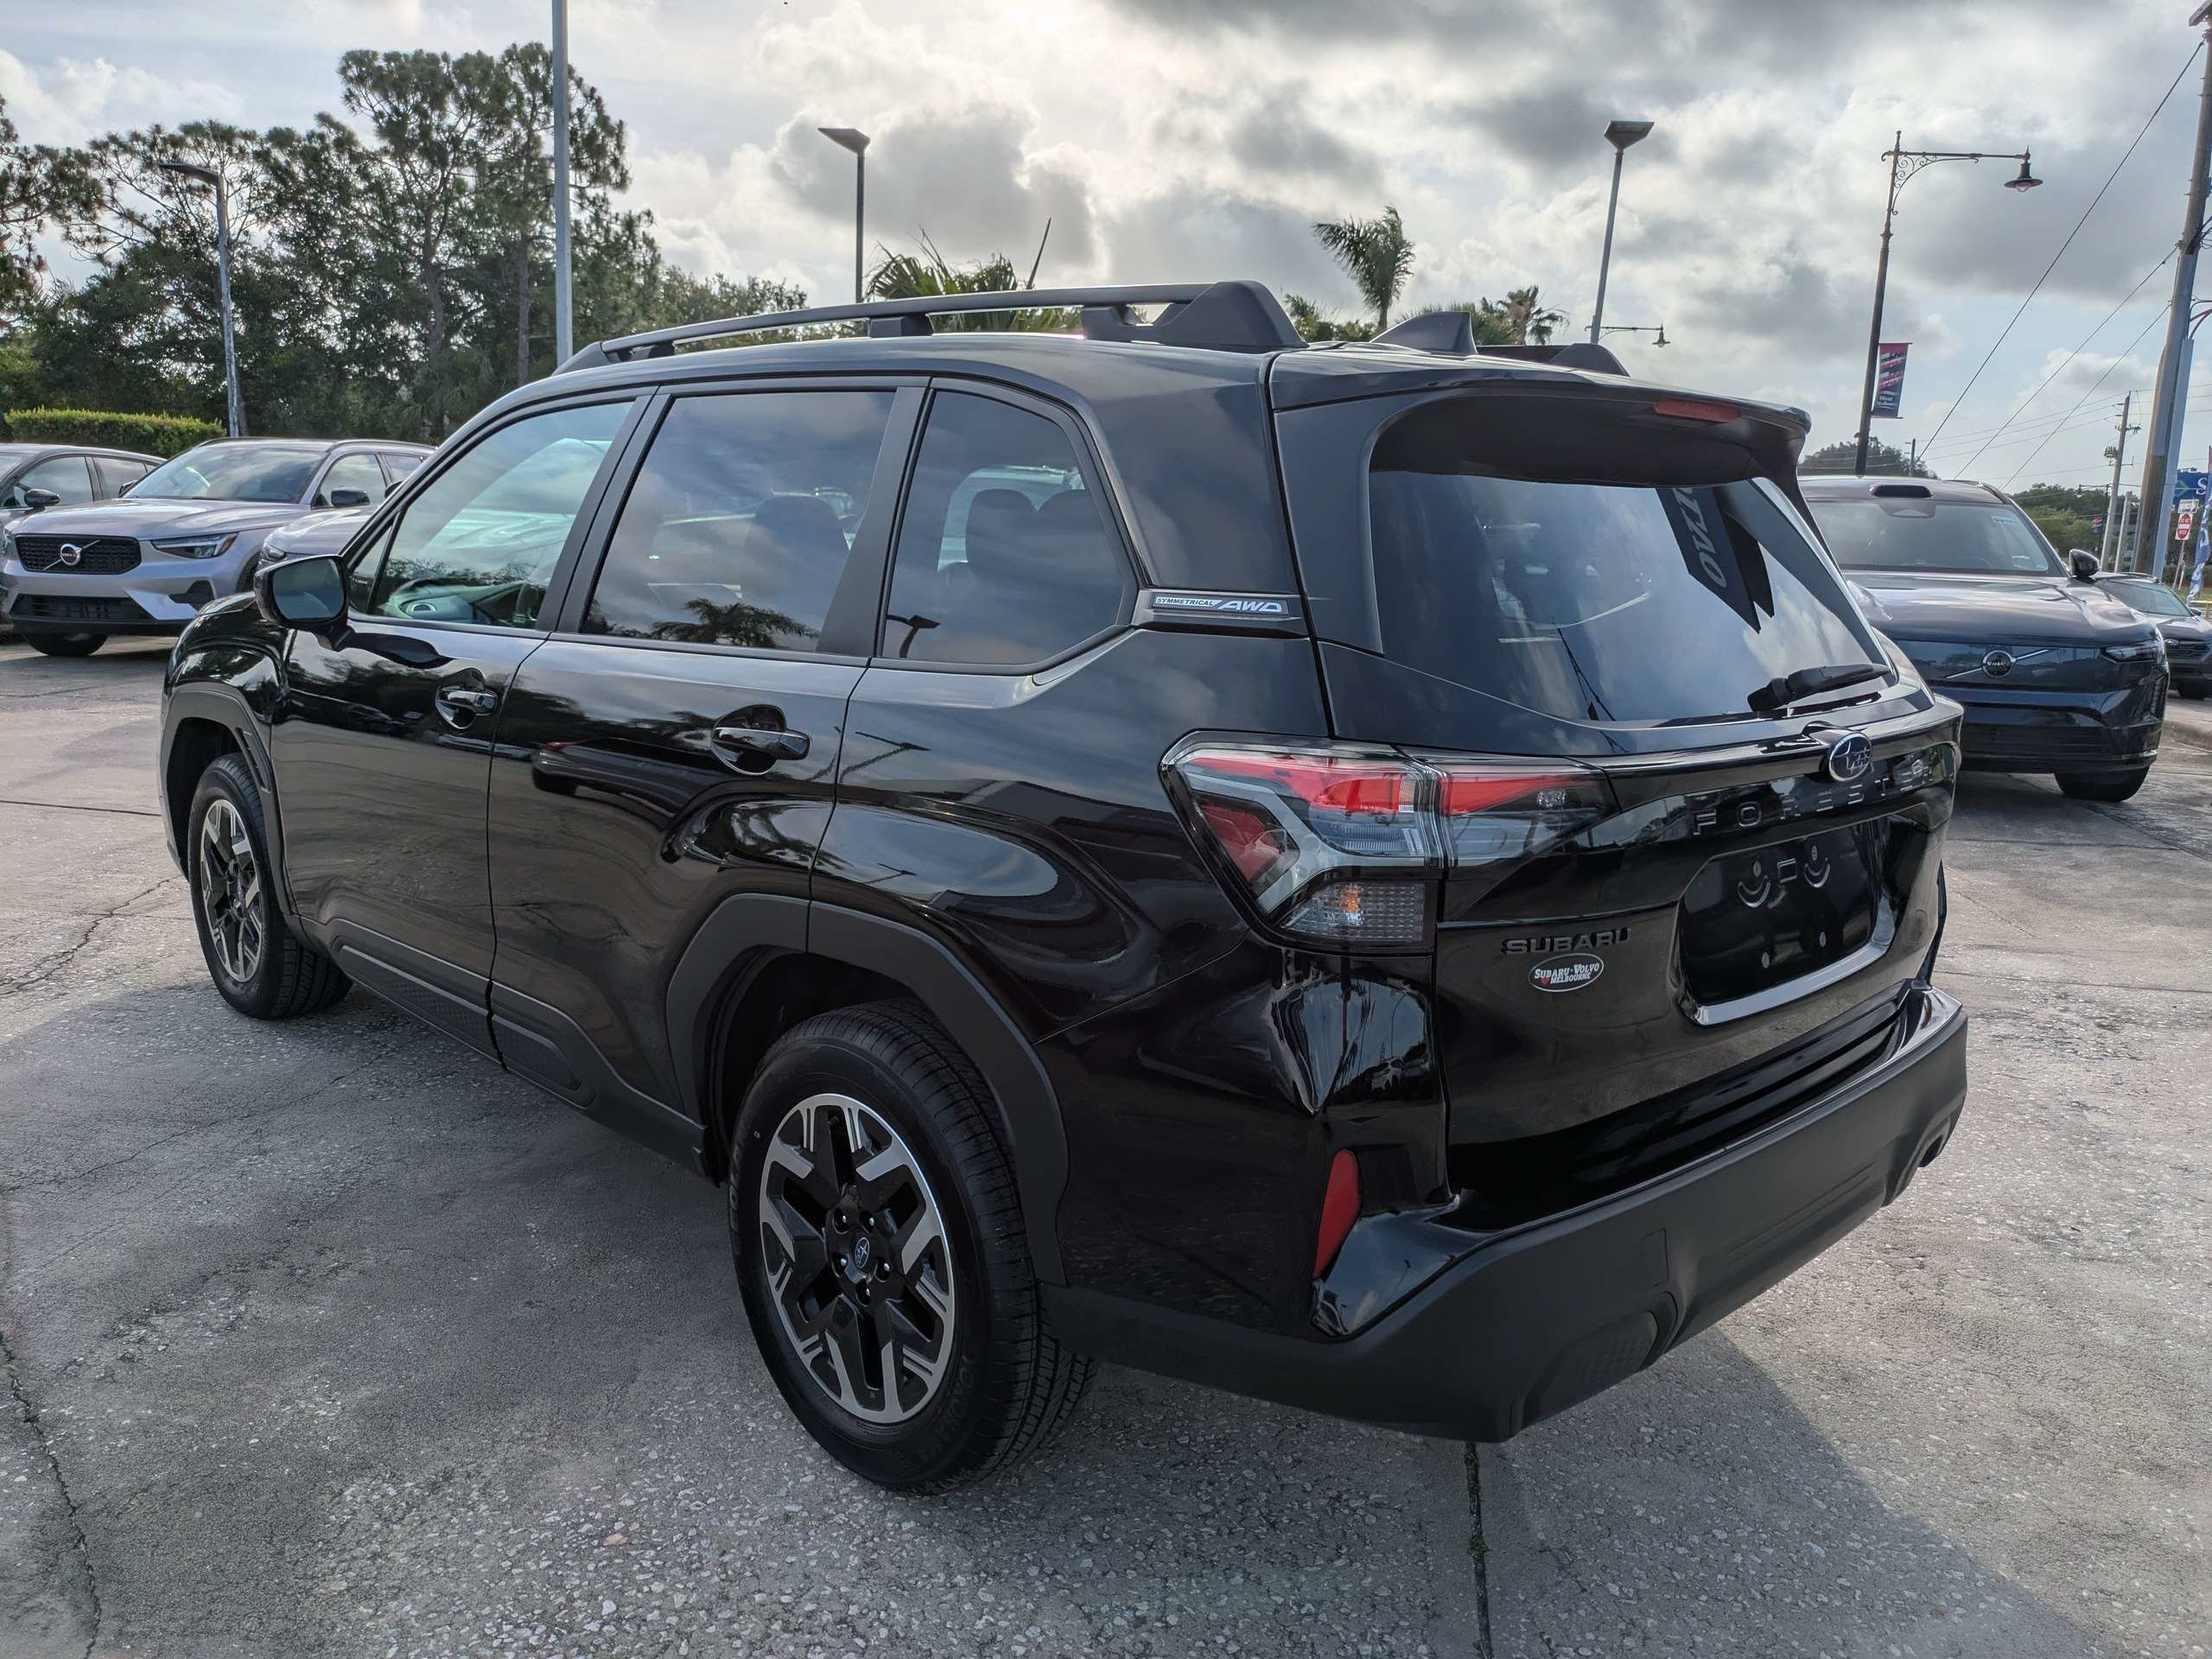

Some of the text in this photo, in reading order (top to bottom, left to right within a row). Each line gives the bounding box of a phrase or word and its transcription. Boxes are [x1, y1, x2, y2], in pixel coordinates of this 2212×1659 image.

[1156, 597, 1282, 613] SYMMETRICAL AWD
[1694, 766, 1933, 836] FORESTER
[1502, 927, 1632, 955] SUBARU
[1535, 963, 1599, 980] SUBARU VOLVO
[1550, 972, 1592, 984] MELBOURNE
